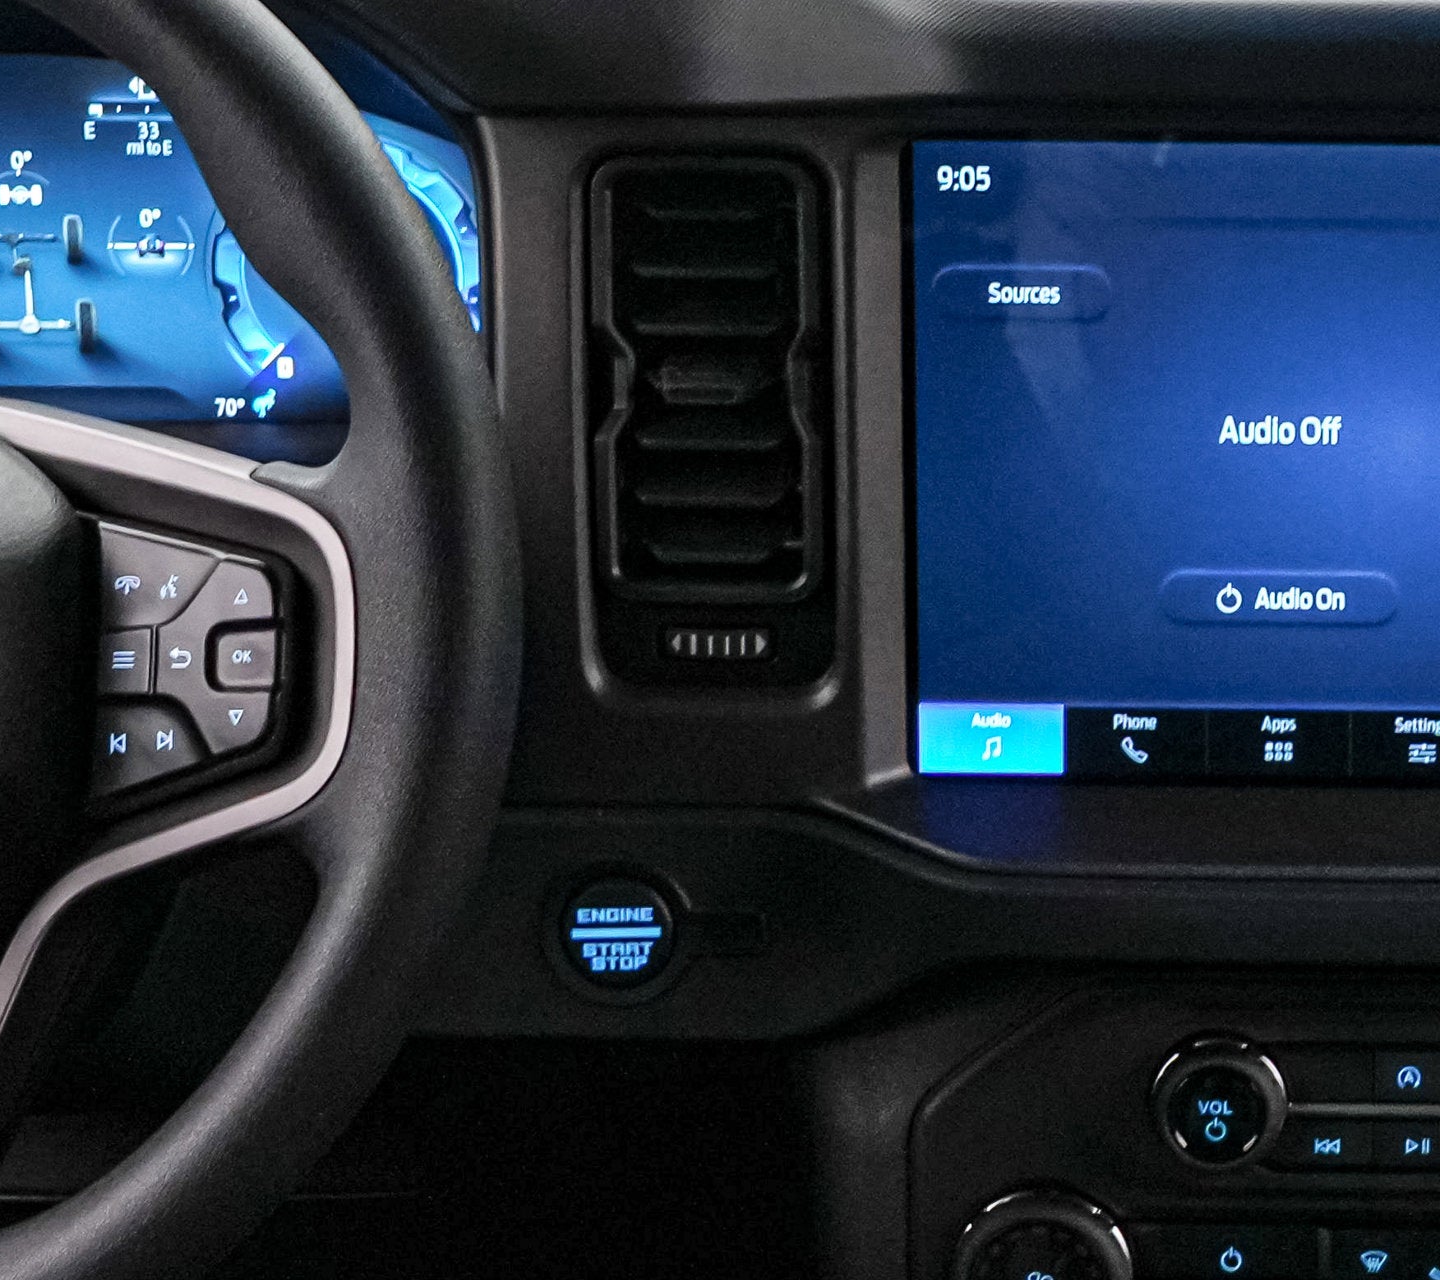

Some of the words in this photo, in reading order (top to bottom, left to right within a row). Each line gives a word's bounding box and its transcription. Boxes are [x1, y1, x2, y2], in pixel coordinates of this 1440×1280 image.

[84, 123, 96, 140] E
[138, 123, 159, 140] 33
[145, 141, 160, 156] to
[163, 140, 172, 156] E
[936, 165, 992, 194] 9:05
[986, 281, 1061, 306] Sources
[1218, 415, 1295, 446] Audio
[1299, 415, 1342, 446] Off
[1254, 587, 1313, 612] Audio
[1316, 587, 1347, 612] On
[231, 649, 252, 664] OK
[971, 713, 1012, 729] Audio
[1113, 713, 1157, 731] Phone
[1260, 716, 1297, 733] Apps
[576, 907, 654, 924] ENGINE
[582, 941, 654, 958] START
[591, 956, 648, 972] STOP
[1198, 1101, 1233, 1116] VOL
